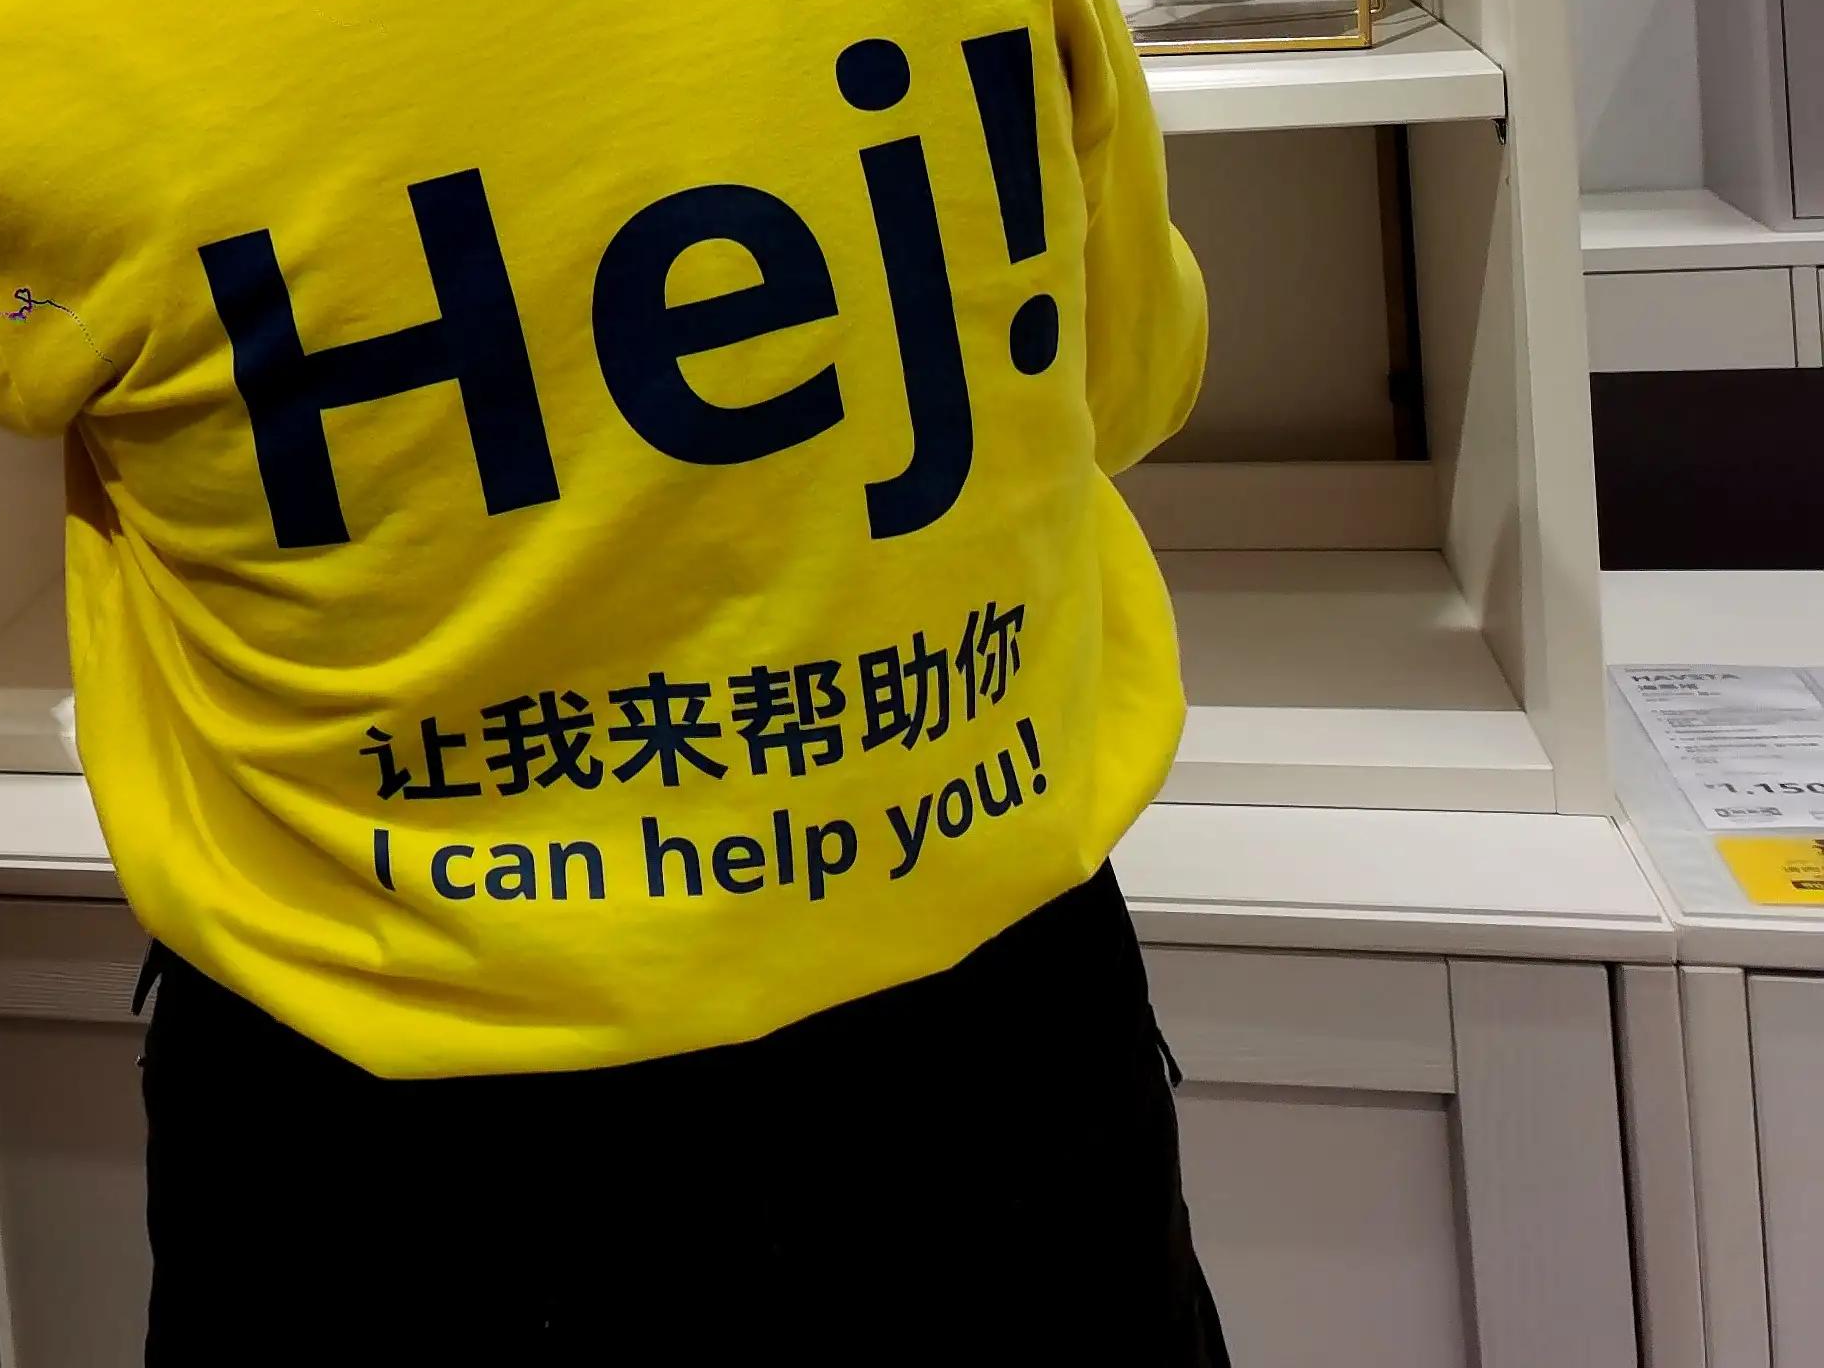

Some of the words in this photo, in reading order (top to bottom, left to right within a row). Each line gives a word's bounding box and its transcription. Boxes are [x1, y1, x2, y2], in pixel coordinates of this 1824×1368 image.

[198, 27, 1059, 549] Hej!
[359, 600, 1026, 800] 让我来帮助你
[373, 828, 397, 892] I
[430, 839, 606, 900] can
[641, 809, 858, 901] help
[885, 716, 1048, 880] you!
